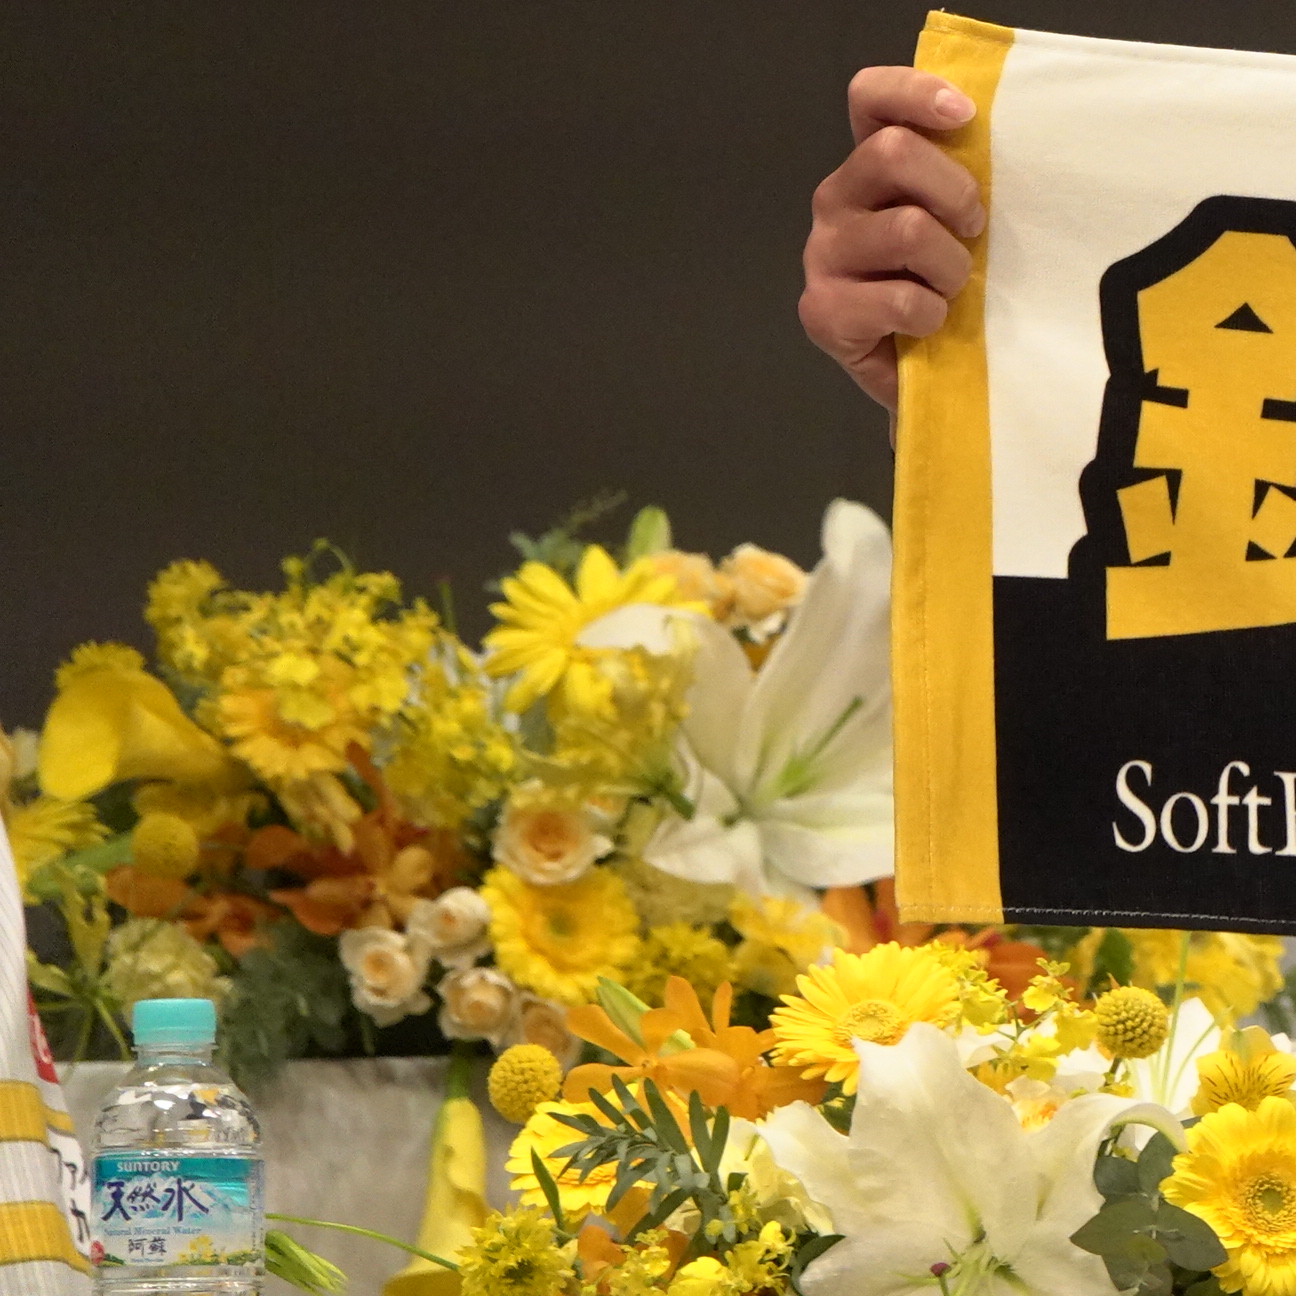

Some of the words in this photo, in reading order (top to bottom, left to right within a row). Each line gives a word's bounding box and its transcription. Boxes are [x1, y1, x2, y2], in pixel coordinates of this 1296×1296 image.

[101, 1177, 210, 1222] 天然水
[128, 1236, 167, 1256] 阿蘇
